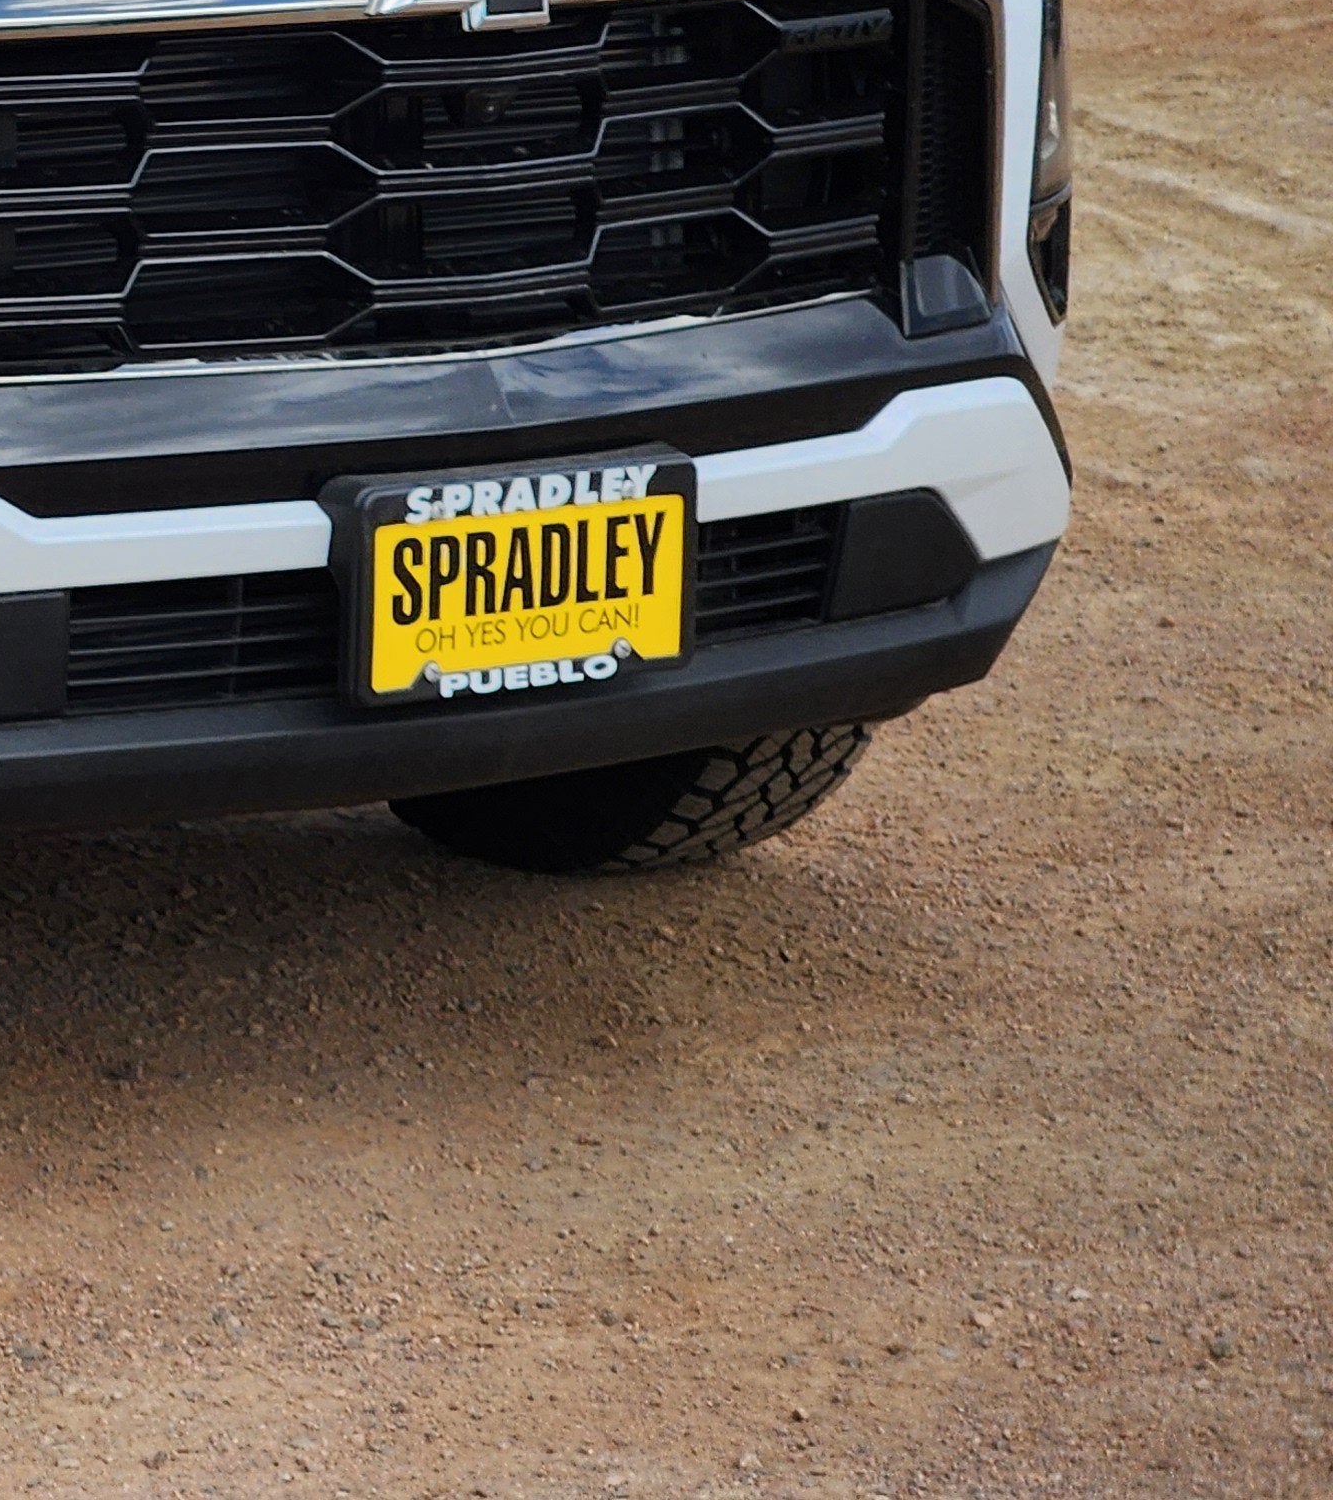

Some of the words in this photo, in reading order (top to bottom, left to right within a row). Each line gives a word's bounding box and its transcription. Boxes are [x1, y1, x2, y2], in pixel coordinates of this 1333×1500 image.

[404, 464, 657, 525] SPRADLEY
[391, 511, 666, 626] SPRADLEY
[415, 627, 456, 654] OH
[464, 618, 506, 648] YES
[515, 611, 571, 642] YOU
[578, 603, 640, 634] CAN!
[439, 654, 618, 698] PUEBLO
